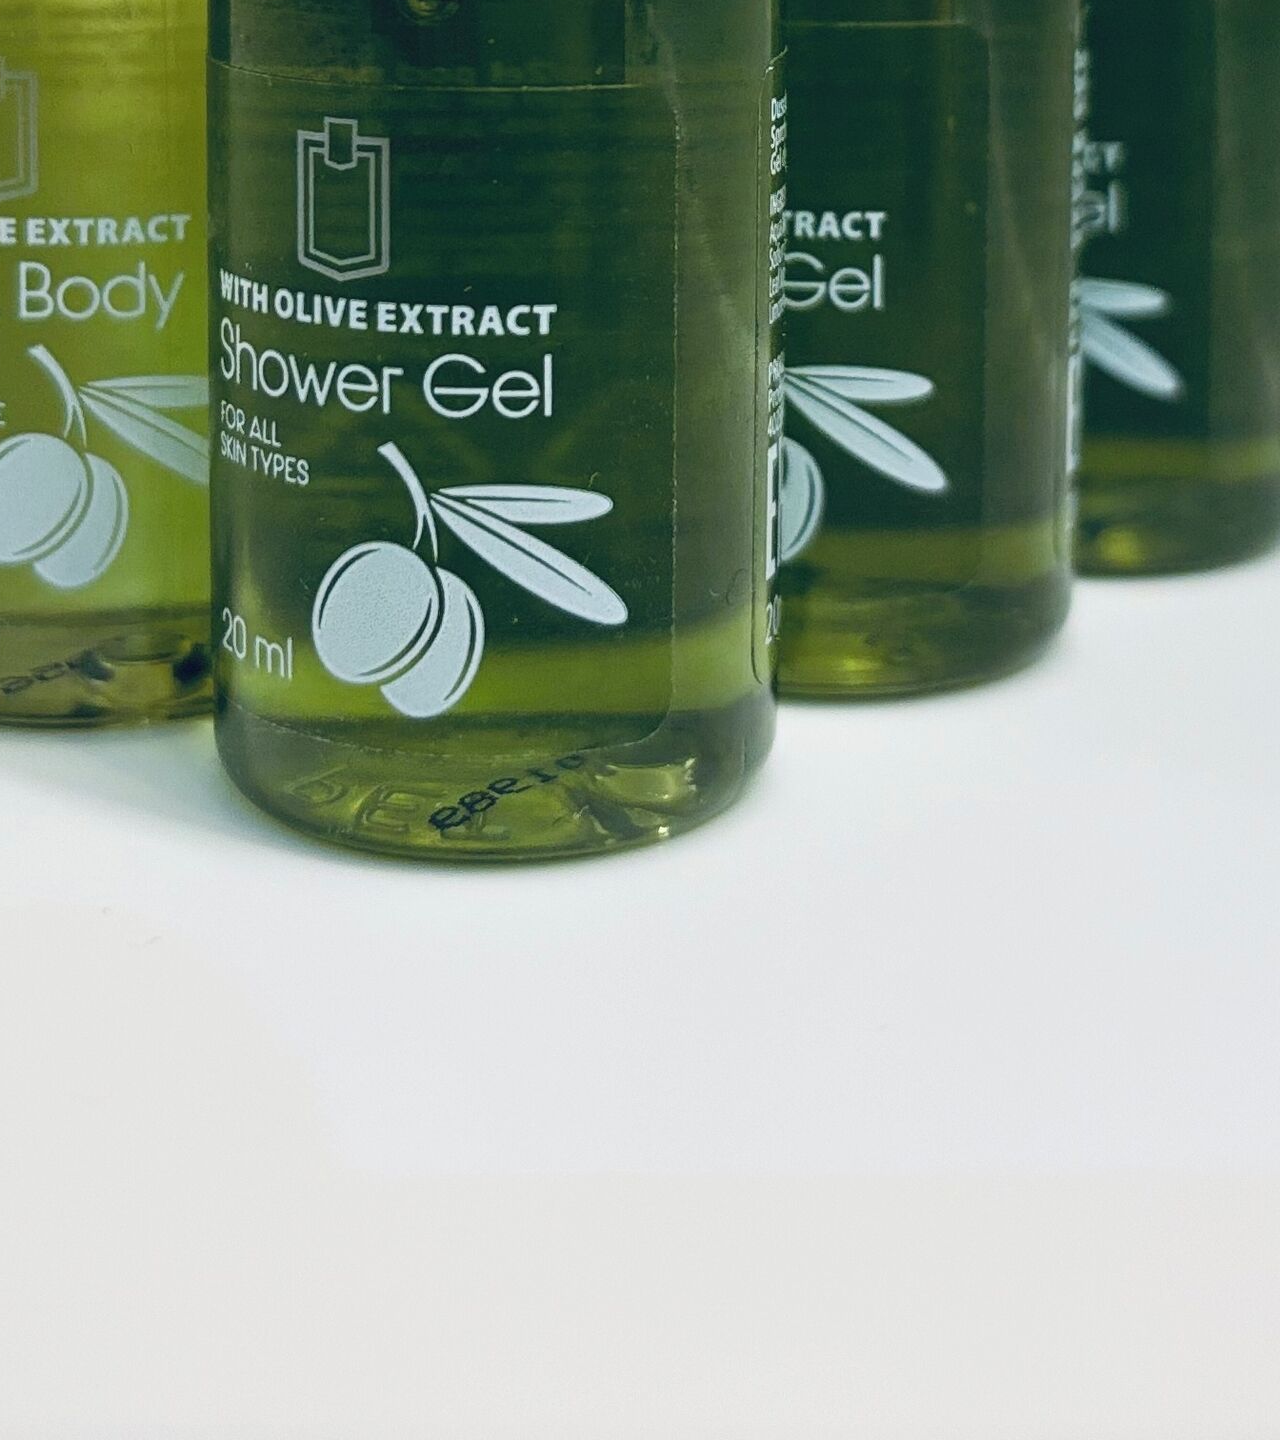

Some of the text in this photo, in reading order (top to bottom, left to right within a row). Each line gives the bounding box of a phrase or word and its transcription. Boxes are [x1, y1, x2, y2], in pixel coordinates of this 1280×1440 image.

[26, 213, 192, 246] EXTRACT
[19, 259, 185, 331] Body
[220, 267, 557, 337] WITH OLIVE EXTRACT
[783, 250, 885, 311] Gel
[220, 316, 553, 419] Shower Gel
[221, 399, 282, 448] FOR ALL
[221, 430, 310, 487] SKIN TYPES
[222, 607, 293, 680] 20 ml
